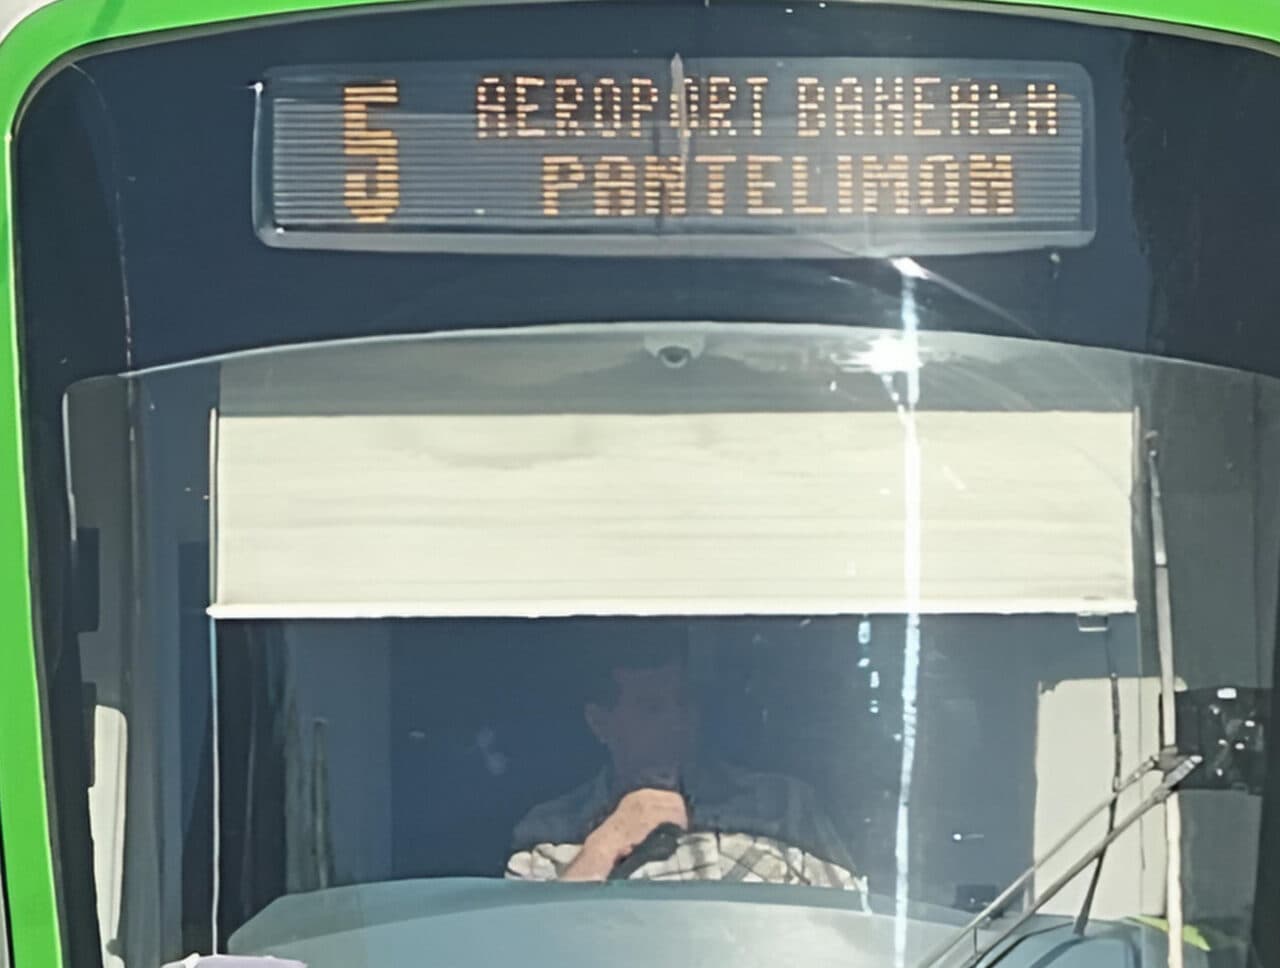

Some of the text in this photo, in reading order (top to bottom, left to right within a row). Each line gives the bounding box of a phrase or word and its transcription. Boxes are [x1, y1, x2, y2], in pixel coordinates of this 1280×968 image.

[476, 76, 768, 138] AEROPORT
[343, 84, 398, 222] 5
[542, 155, 1014, 215] PANTELIMON
